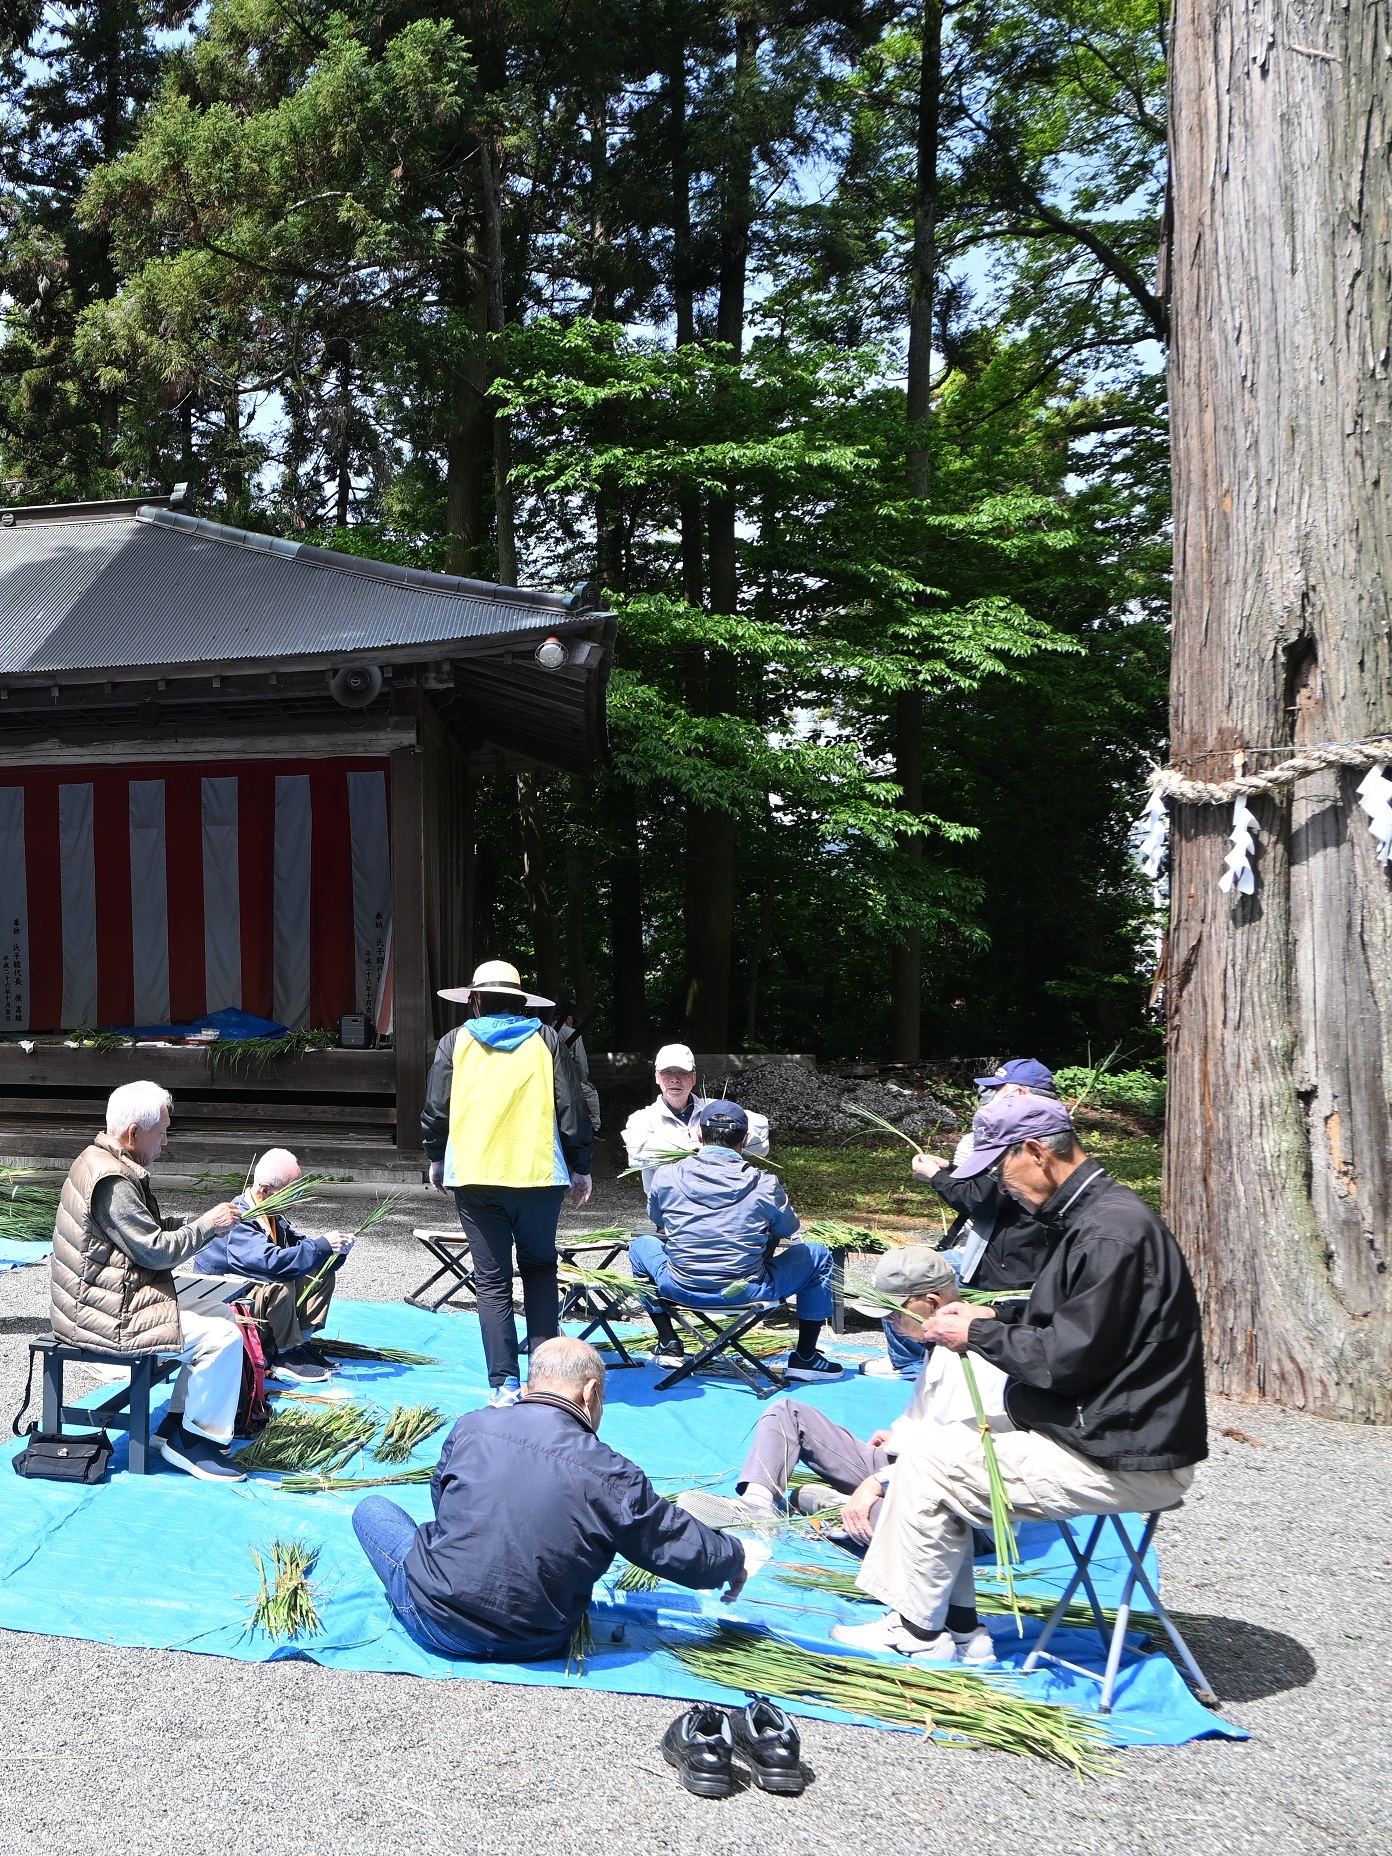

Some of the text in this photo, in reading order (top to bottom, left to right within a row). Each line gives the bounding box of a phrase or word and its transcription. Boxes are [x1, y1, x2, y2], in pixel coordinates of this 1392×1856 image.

[13, 919, 20, 934] 奉納
[375, 912, 383, 929] 奉納
[365, 950, 373, 1017] 平成二十六年十月吉
